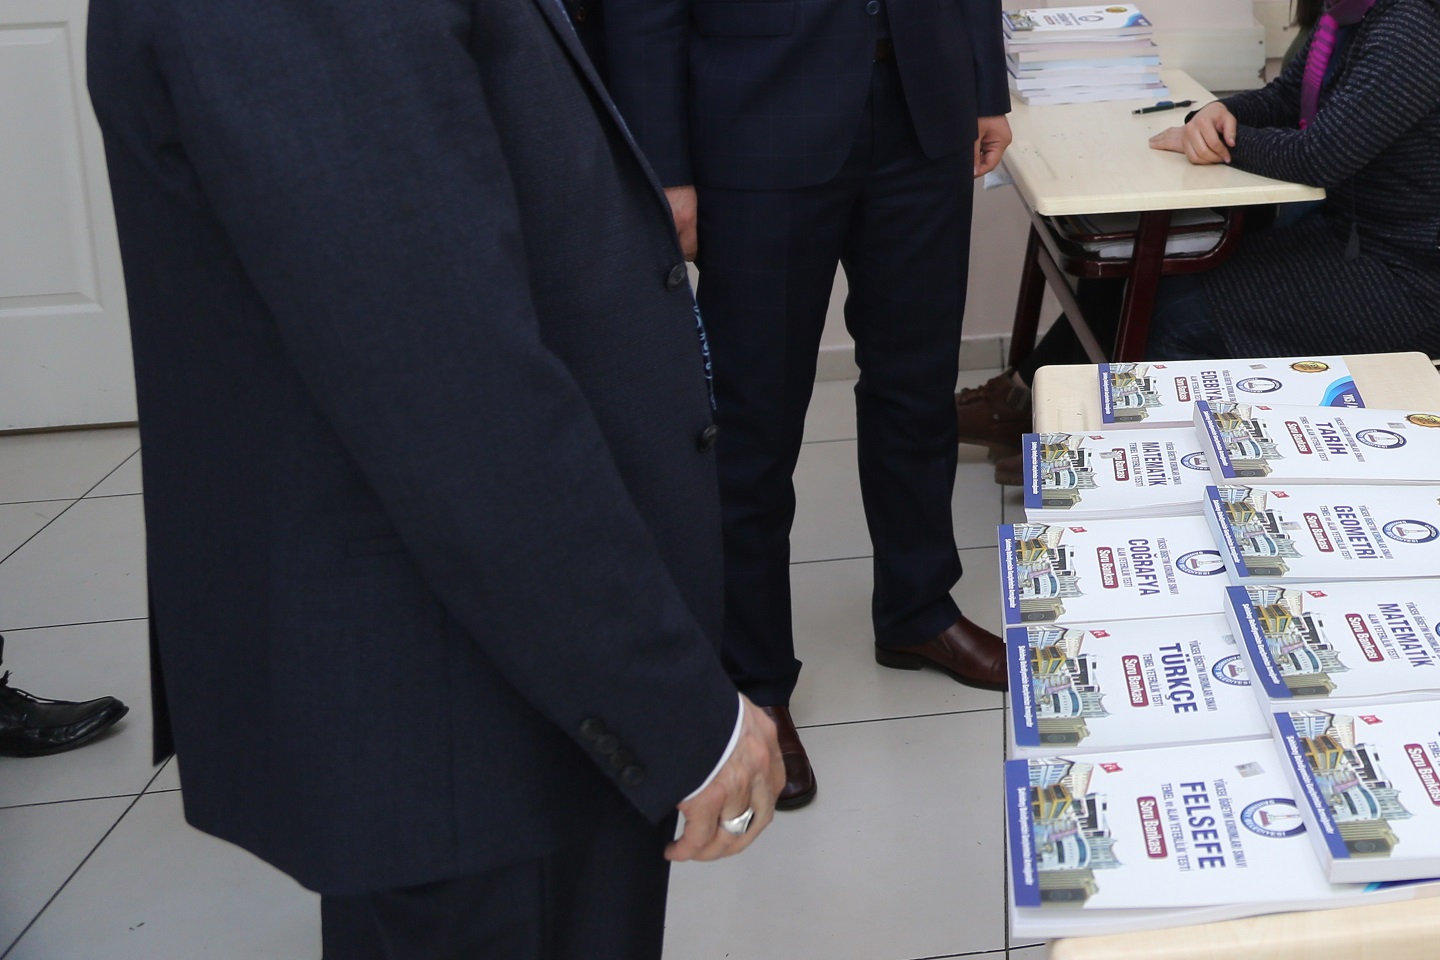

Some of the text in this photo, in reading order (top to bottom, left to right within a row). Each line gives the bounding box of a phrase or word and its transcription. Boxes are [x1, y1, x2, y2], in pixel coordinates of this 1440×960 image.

[1201, 371, 1224, 402] EDEBİYA
[1316, 422, 1348, 454] TARİH
[1142, 442, 1171, 486] MATEMATİK
[1333, 506, 1384, 559] GEOMETRİ
[1099, 549, 1111, 562] Soru
[1128, 539, 1160, 596] COĞRAFYA
[1349, 617, 1378, 659] Soru Bankası
[1367, 614, 1380, 624] ALAN
[1377, 603, 1436, 667] MATEMATİK
[1125, 658, 1143, 703] Soru Bankası
[1143, 653, 1155, 668] TEMEL
[1152, 694, 1165, 706] TESTİ
[1159, 642, 1198, 714] TÜRKÇE
[1408, 747, 1427, 767] Soru
[1161, 783, 1173, 800] TEMEL
[1141, 801, 1162, 854] Soru Bankası
[1167, 809, 1179, 821] ALAN
[1180, 782, 1226, 869] FELSEFE
[1214, 779, 1227, 796] YÜKSEK
[1224, 820, 1241, 849] KURUMLARI
[1233, 851, 1247, 868] SINAVI
[1170, 822, 1187, 853] YETERLİLİK
[1176, 855, 1194, 872] TESTİ
